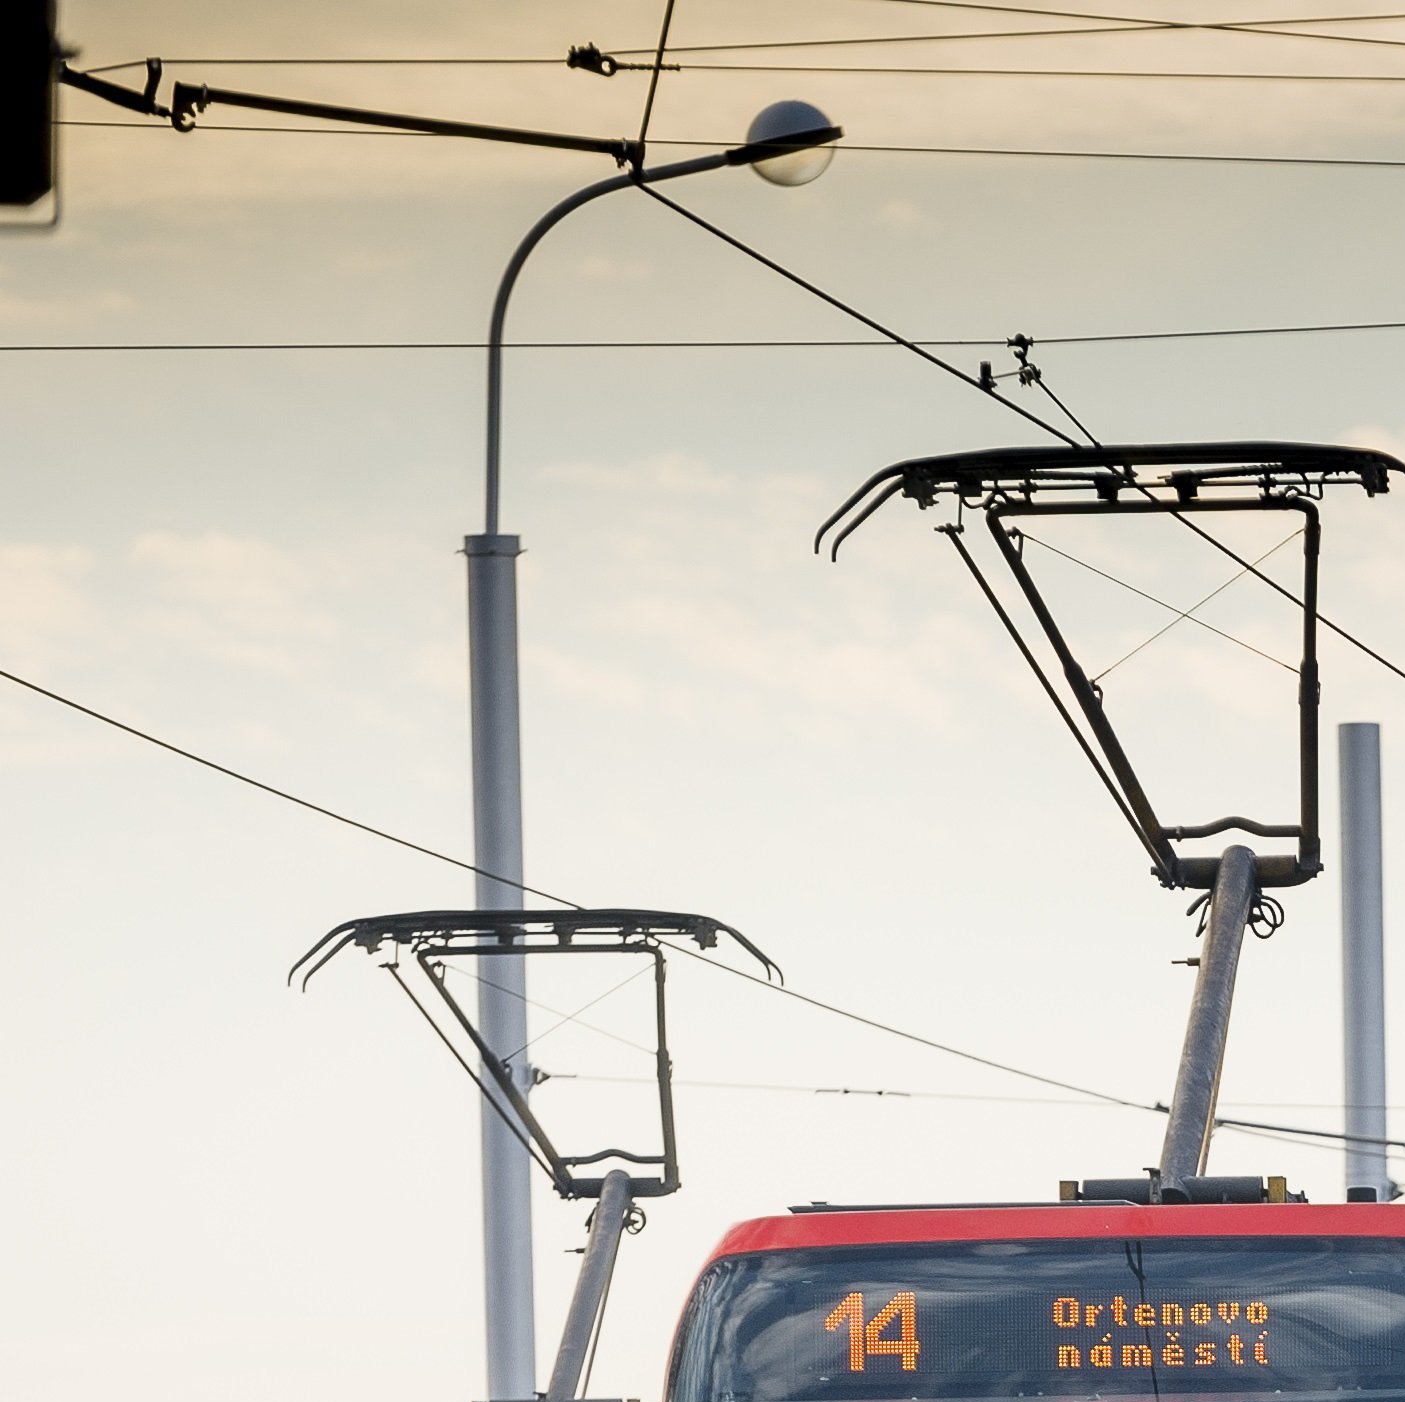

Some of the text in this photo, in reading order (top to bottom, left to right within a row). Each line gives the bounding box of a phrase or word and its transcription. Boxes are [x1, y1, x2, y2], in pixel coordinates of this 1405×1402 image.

[1051, 1294, 1270, 1328] Ortenovo
[824, 1291, 920, 1371] 14
[1056, 1330, 1271, 1369] náměstí
